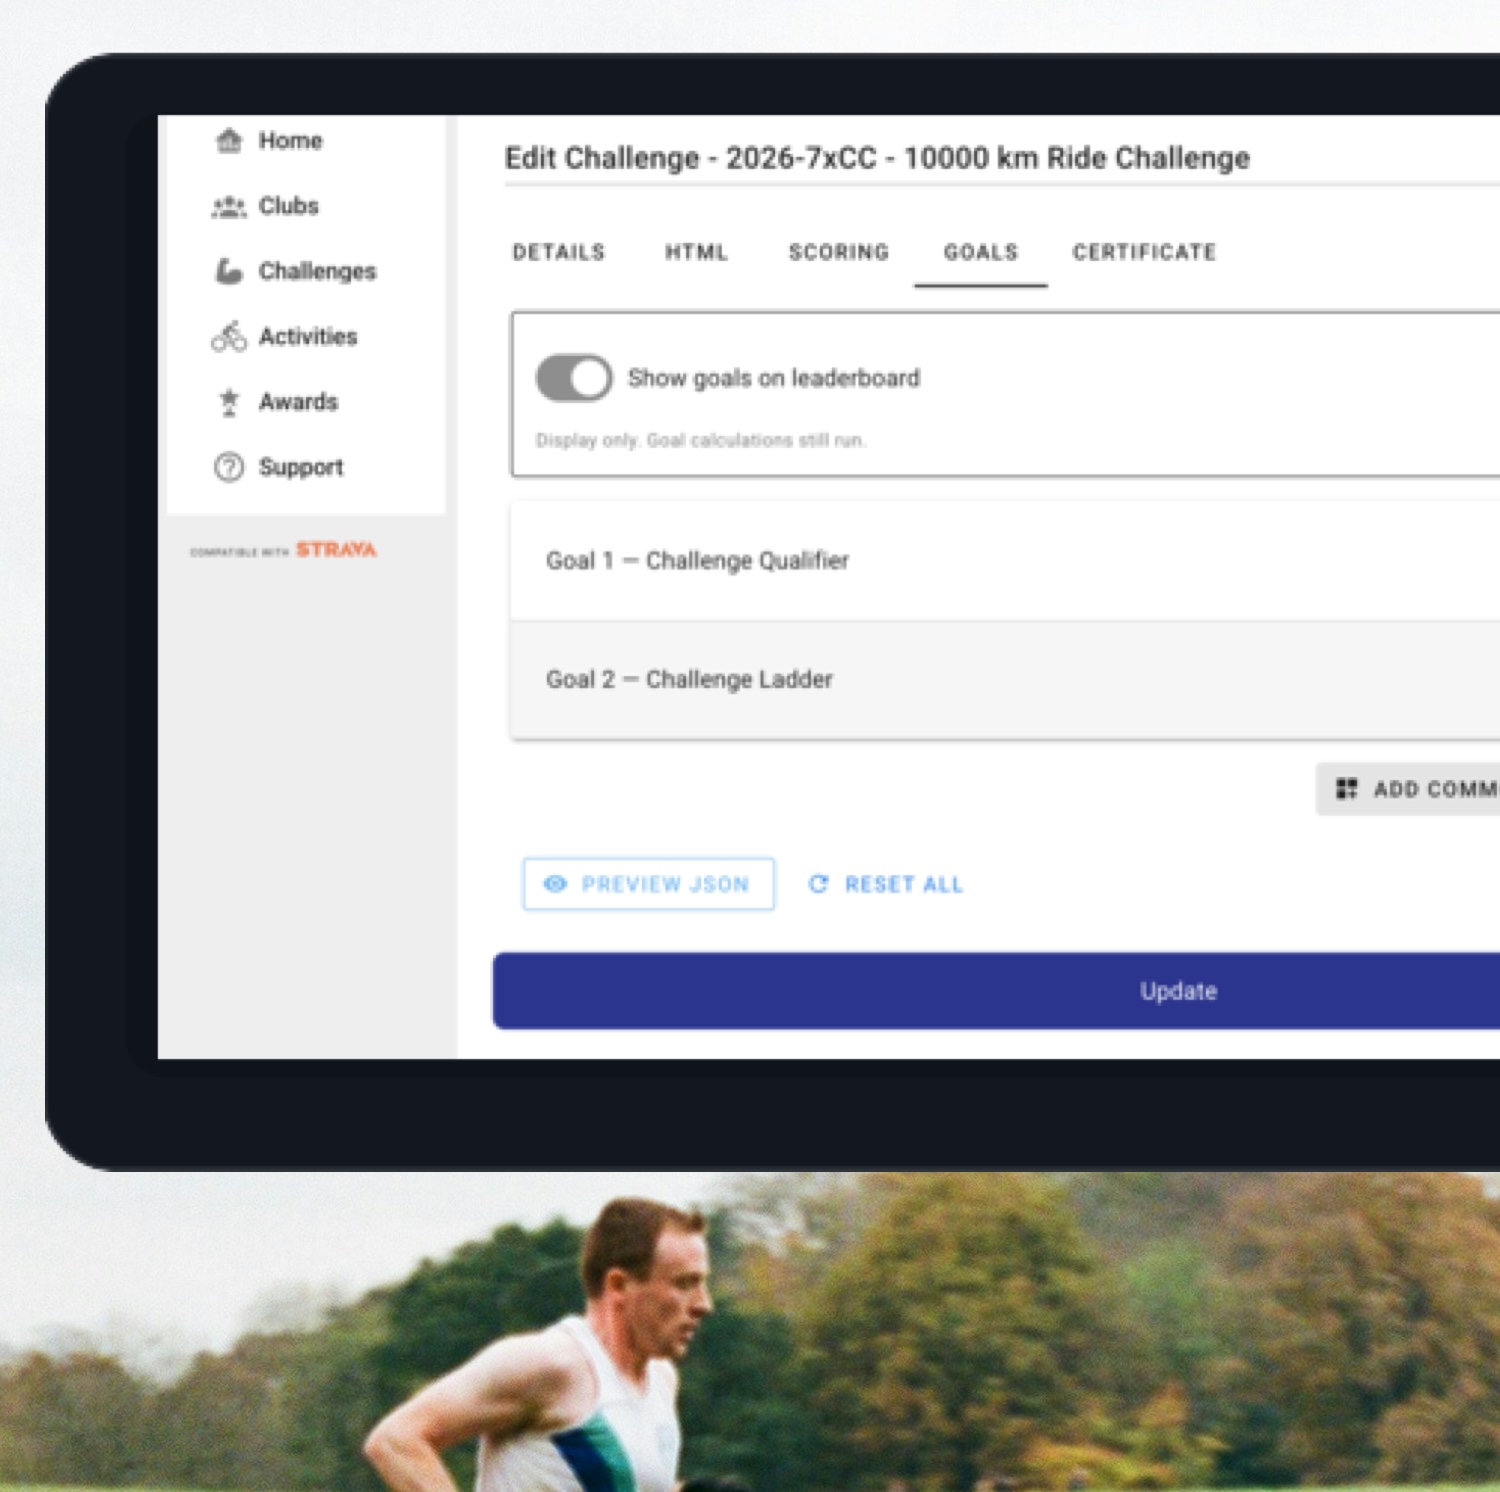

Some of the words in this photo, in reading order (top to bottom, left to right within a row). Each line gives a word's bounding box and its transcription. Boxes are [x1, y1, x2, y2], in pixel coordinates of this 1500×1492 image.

[258, 130, 323, 151] Home
[504, 144, 557, 170] Edit
[564, 144, 700, 176] Challenge
[727, 144, 877, 170] 2026-7xCC
[905, 144, 990, 170] 10000
[997, 144, 1039, 170] km
[1047, 144, 1108, 170] Ride
[1115, 144, 1251, 176] Challenge
[258, 195, 319, 216] Clubs
[513, 242, 604, 262] DETAILS
[665, 242, 728, 262] HTML
[789, 242, 889, 262] SCORING
[943, 242, 1019, 262] GOALS
[1072, 242, 1216, 262] CERTIFICATE
[258, 260, 377, 285] Challenges
[258, 326, 358, 347] Activities
[628, 367, 687, 389] Show
[693, 367, 753, 393] goals
[757, 372, 785, 389] on
[792, 367, 921, 389] leaderboard
[258, 391, 339, 412] Awards
[536, 432, 598, 451] Display
[602, 432, 642, 452] only.
[646, 432, 686, 449] Goal
[690, 432, 794, 449] calculations
[798, 432, 830, 449] still
[834, 435, 867, 449] run.
[258, 456, 344, 481] Support
[296, 540, 377, 558] STRAVA
[546, 550, 595, 571] Goal
[603, 550, 613, 570] 1
[646, 550, 753, 576] Challenge
[759, 549, 850, 573] Qualifier
[546, 668, 595, 689] Goal
[602, 669, 616, 689] 2
[646, 668, 753, 695] Challenge
[759, 668, 833, 689] Ladder
[1374, 779, 1420, 799] ADD
[582, 874, 681, 894] PREVIEW
[689, 874, 749, 894] JSON
[845, 874, 915, 894] RESET
[923, 875, 963, 894] ALL
[1140, 980, 1218, 1005] Update
